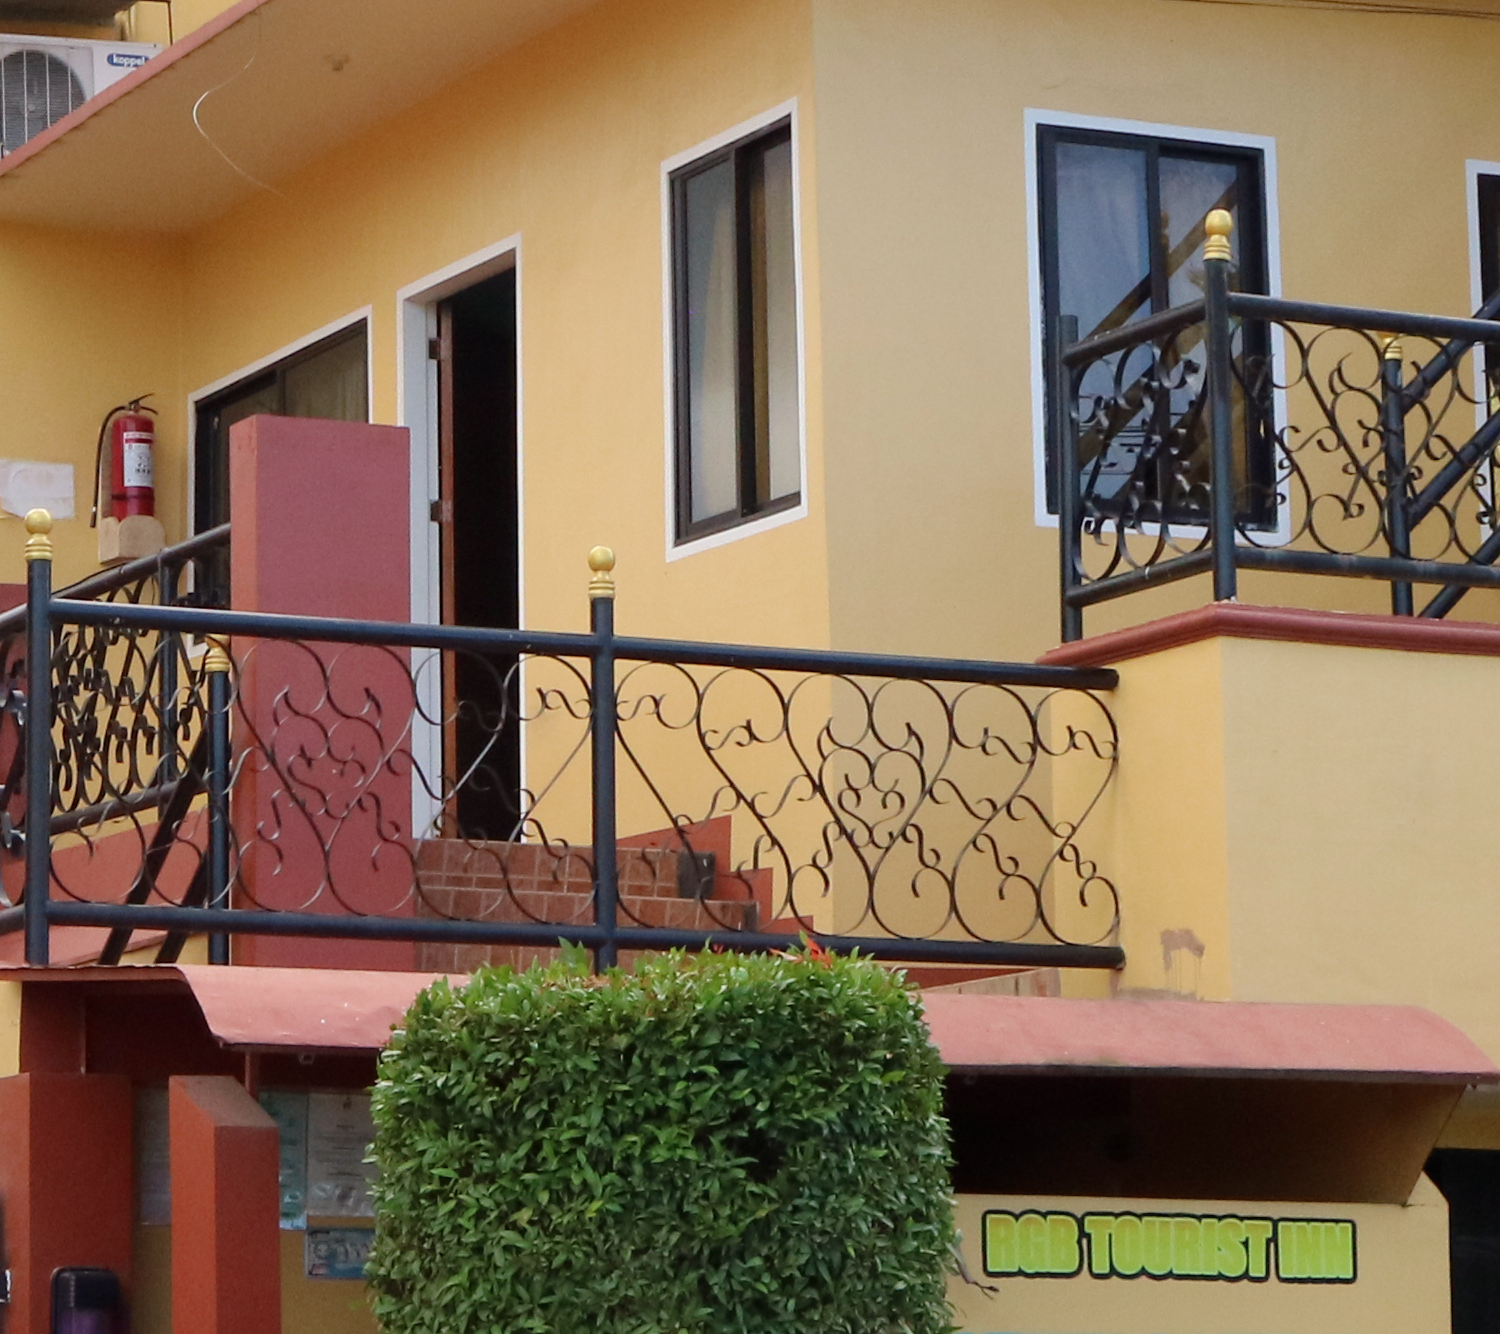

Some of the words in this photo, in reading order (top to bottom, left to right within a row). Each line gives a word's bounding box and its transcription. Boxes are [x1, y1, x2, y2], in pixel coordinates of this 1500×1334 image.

[112, 53, 146, 67] koppel
[983, 1210, 1083, 1277] RGB
[1084, 1213, 1273, 1281] TOURIST
[1277, 1218, 1357, 1283] INN
